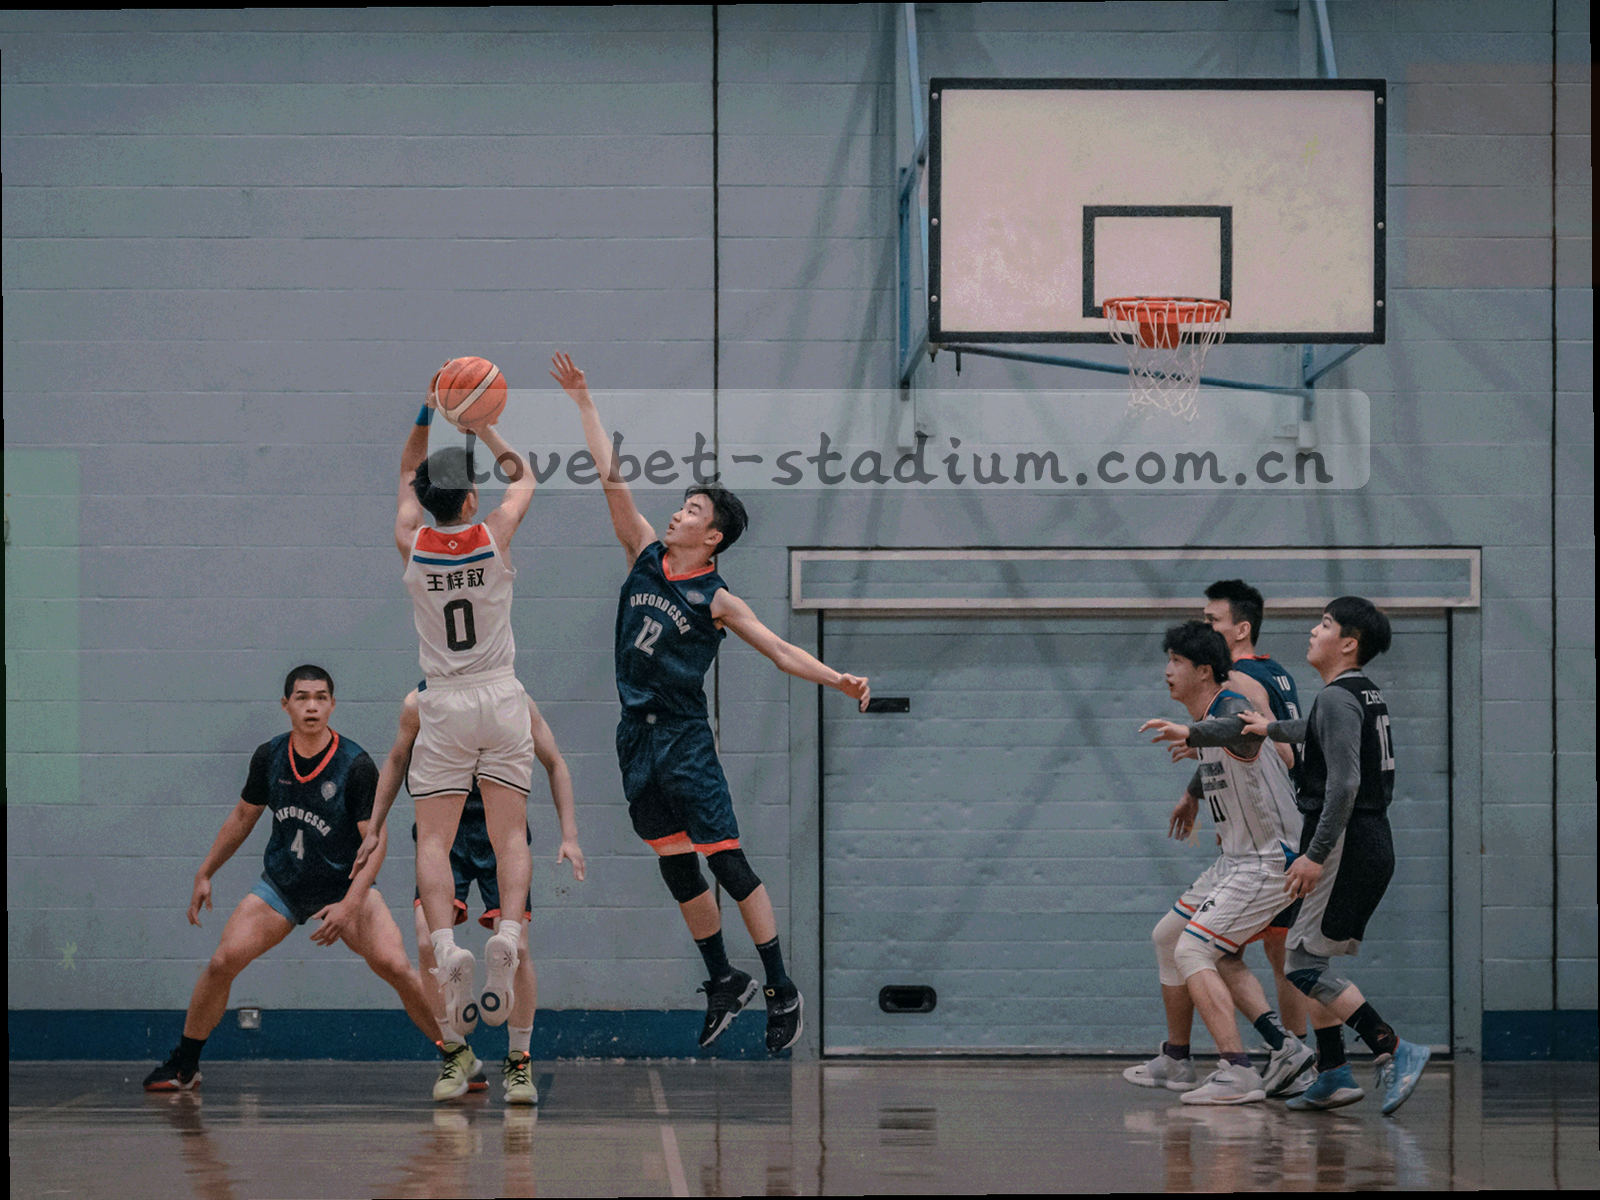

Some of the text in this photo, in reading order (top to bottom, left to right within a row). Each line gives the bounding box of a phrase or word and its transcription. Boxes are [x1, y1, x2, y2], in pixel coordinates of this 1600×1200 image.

[426, 568, 485, 592] 王梓叙
[443, 598, 477, 652] 0
[634, 615, 663, 656] 12
[290, 829, 305, 860] 4
